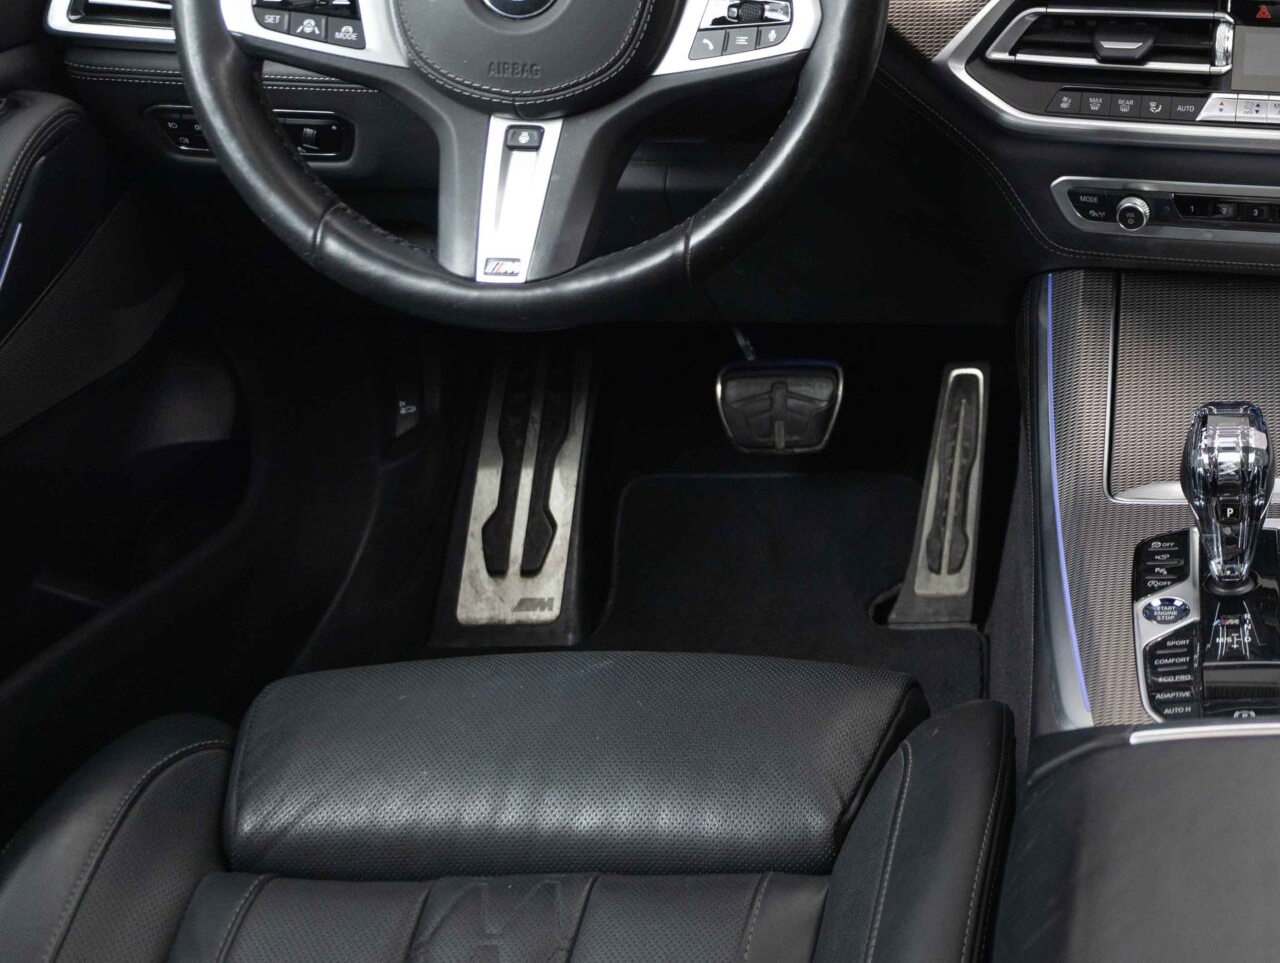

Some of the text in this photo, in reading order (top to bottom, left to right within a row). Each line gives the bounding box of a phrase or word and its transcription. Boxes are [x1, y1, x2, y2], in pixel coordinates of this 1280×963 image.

[264, 15, 281, 23] SET
[335, 32, 358, 40] MODE
[488, 62, 542, 78] AIRBAG
[1080, 195, 1098, 203] MODE
[1226, 508, 1234, 518] P
[1154, 657, 1190, 665] COMFORT
[1155, 691, 1191, 700] ADAPTIVE
